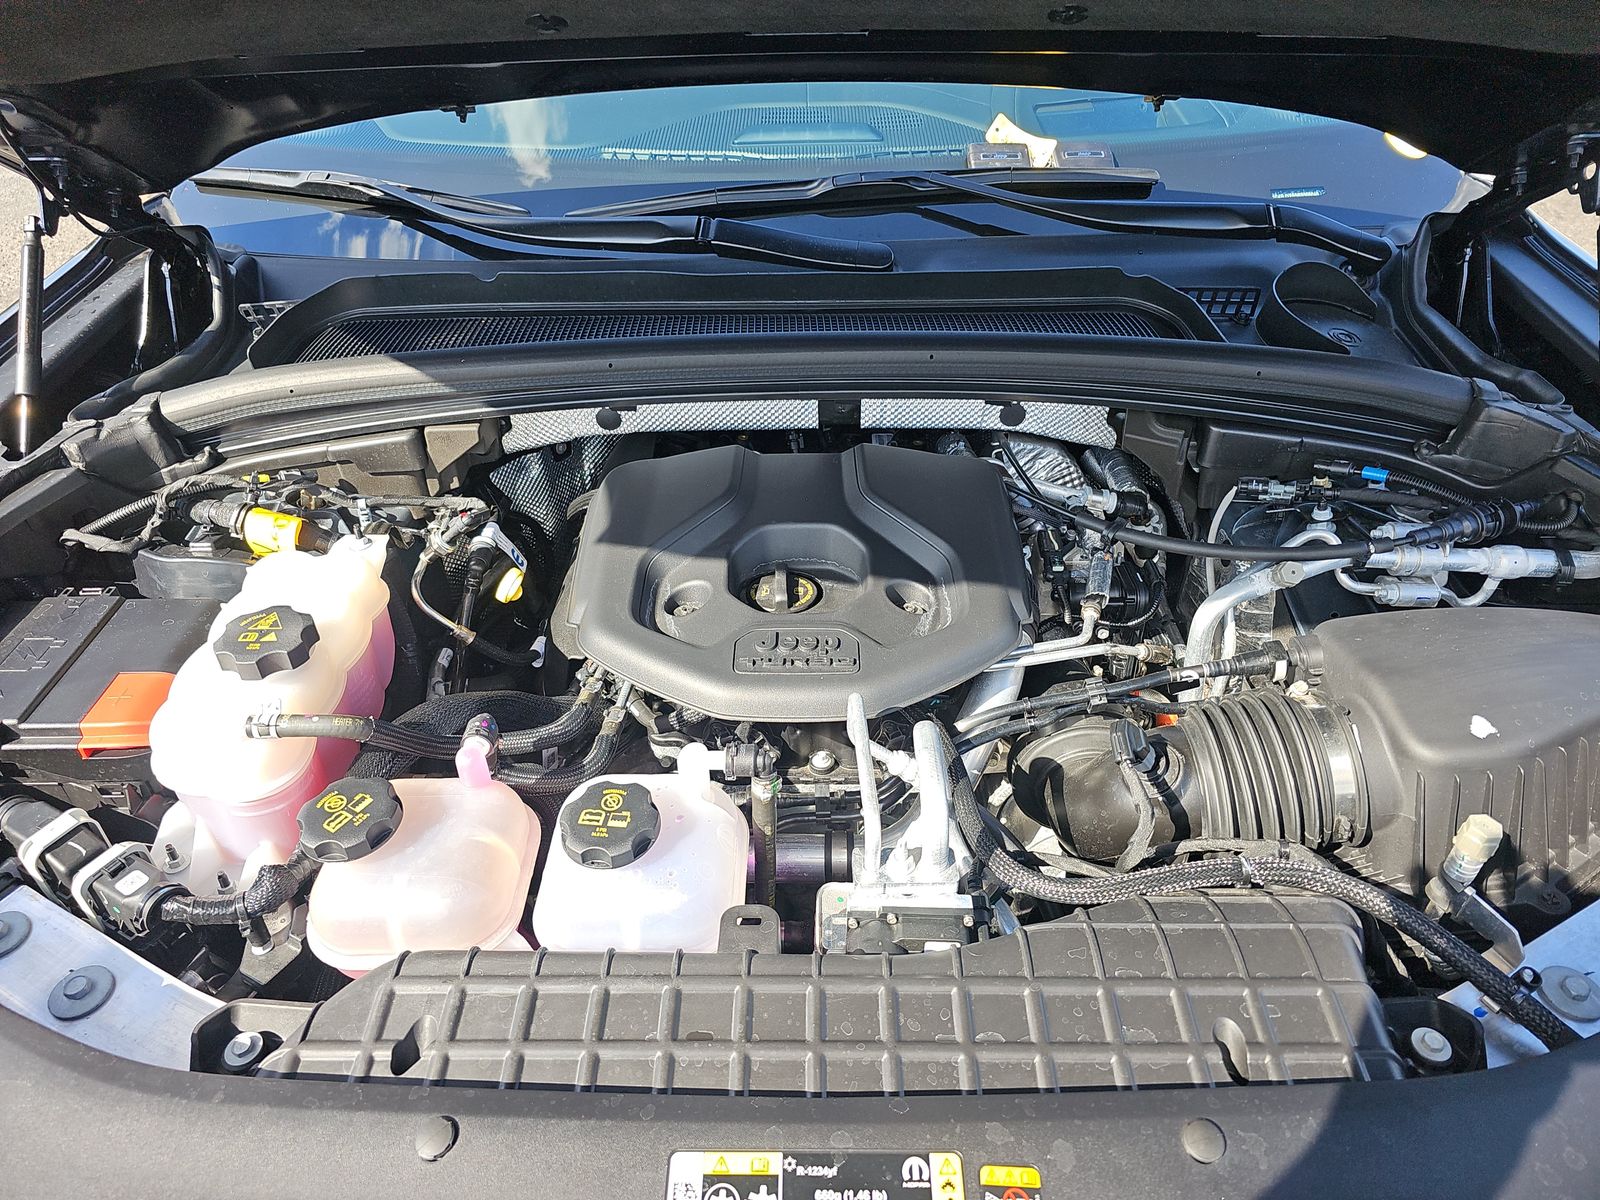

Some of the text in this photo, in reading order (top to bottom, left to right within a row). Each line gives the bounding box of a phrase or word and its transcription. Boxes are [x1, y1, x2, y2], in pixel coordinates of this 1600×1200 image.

[754, 631, 842, 657] Jeep
[739, 657, 858, 669] TURBO
[796, 1165, 839, 1178] R-1234yf
